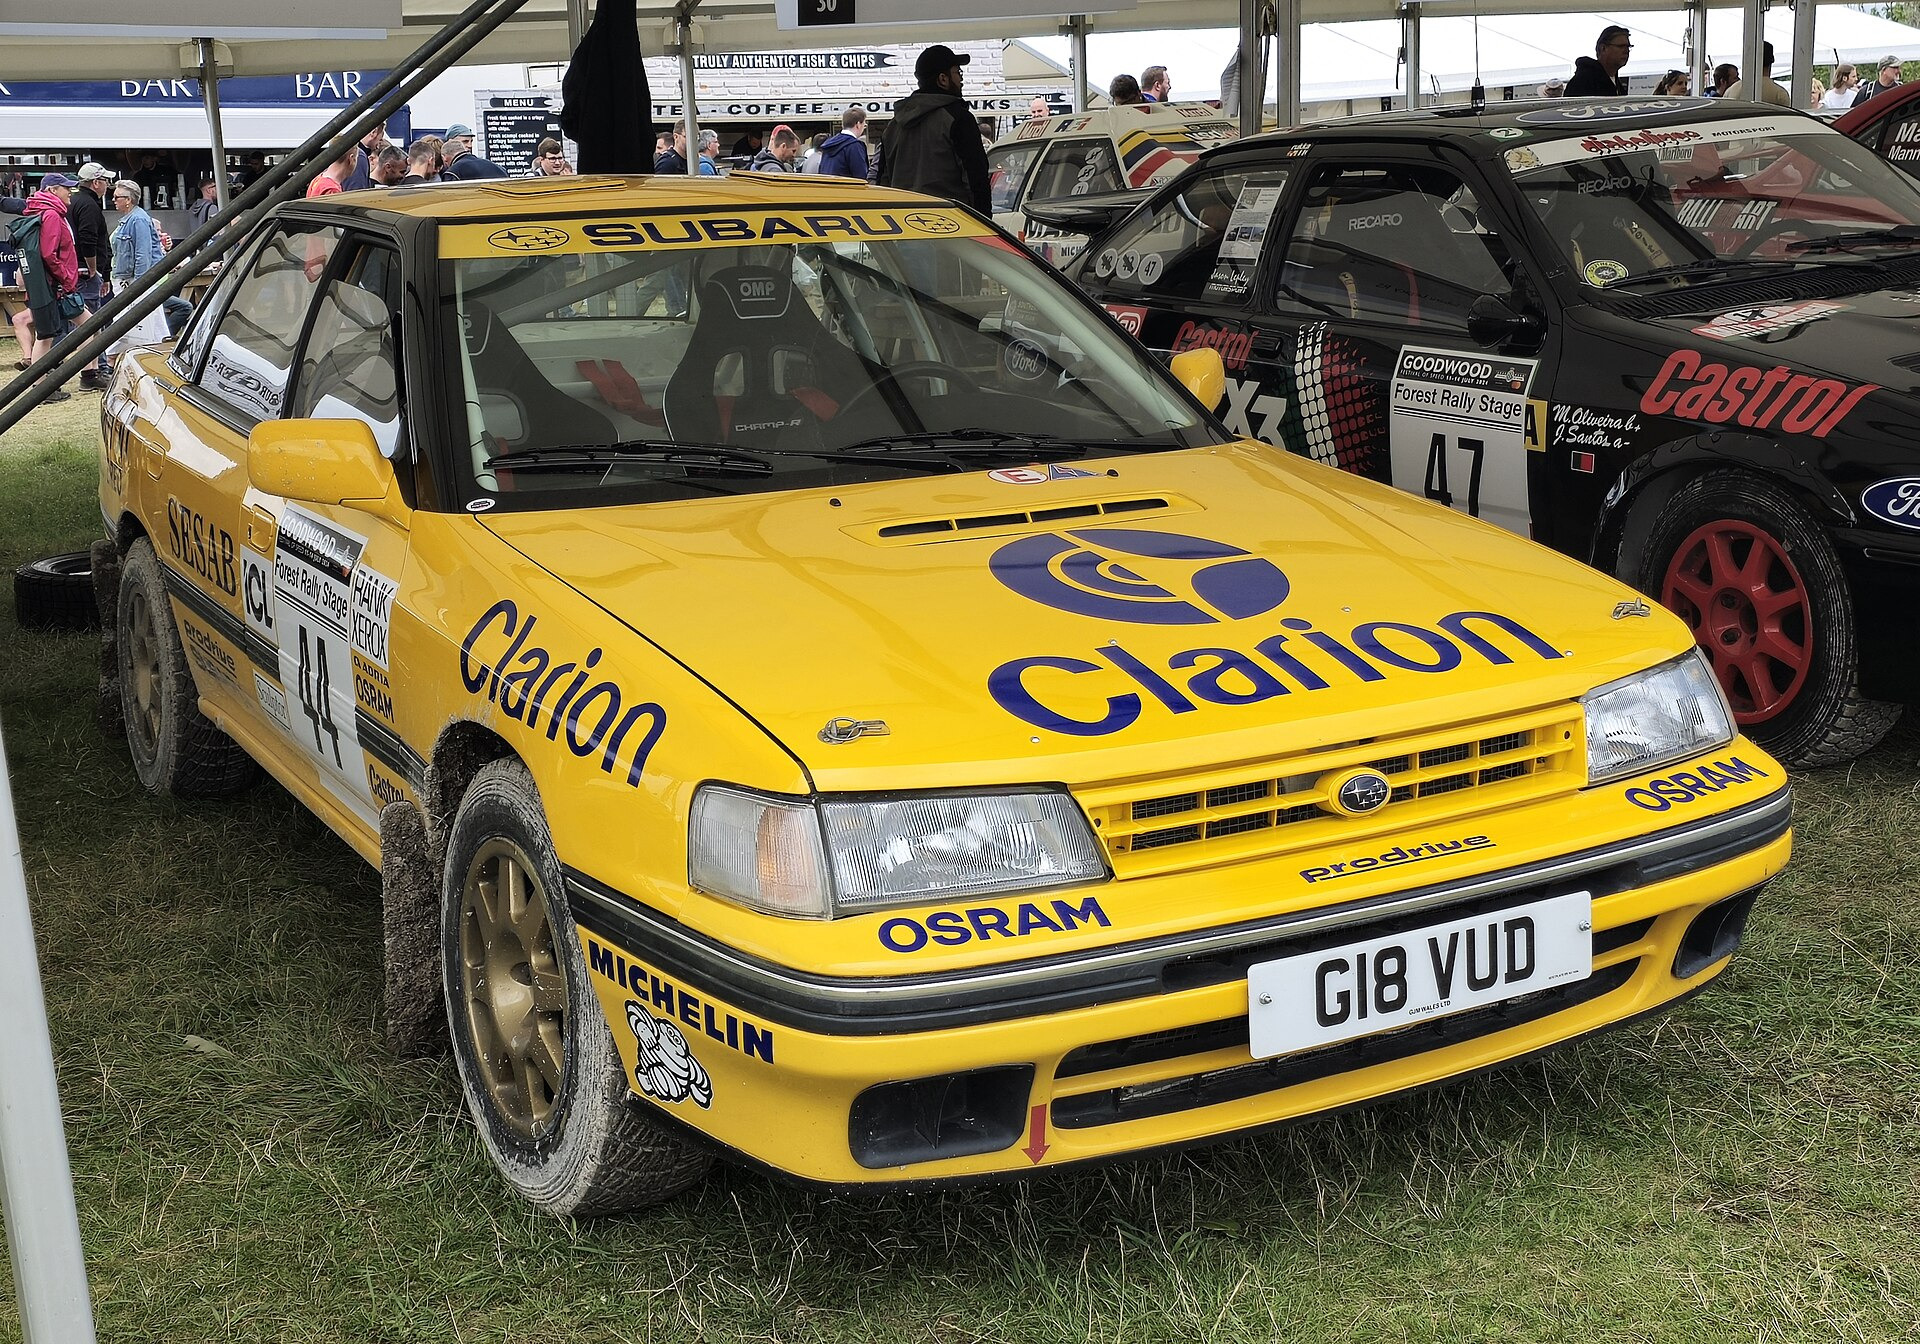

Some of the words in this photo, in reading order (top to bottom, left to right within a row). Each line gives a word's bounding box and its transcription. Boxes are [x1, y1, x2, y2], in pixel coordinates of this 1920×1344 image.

[693, 55, 730, 68] TRULY
[732, 54, 797, 68] AUTHENTIC
[799, 54, 826, 68] FISH
[829, 55, 838, 67] &
[840, 54, 876, 68] CHIPS
[121, 80, 193, 97] BAR
[296, 72, 363, 98] BAR
[504, 99, 534, 107] MENU
[653, 104, 700, 116] TE
[727, 104, 824, 115] COFFEE
[1556, 100, 1681, 118] Ford
[1711, 126, 1777, 137] MOTORSPORT
[1577, 175, 1632, 194] RECARO
[582, 214, 904, 247] SUBARU
[1348, 212, 1403, 231] RECARO
[740, 281, 775, 297] OMP
[1144, 261, 1157, 281] 47
[1011, 342, 1040, 373] Ford
[1402, 355, 1493, 379] GOODWOOD
[1394, 383, 1438, 404] Forest
[1441, 389, 1476, 413] Rally
[1479, 394, 1523, 420] Stage
[1640, 349, 1883, 437] Castrol
[735, 418, 802, 432] CHAMP-R
[1422, 432, 1485, 518] 47
[168, 497, 237, 597] SESAB
[280, 515, 337, 558] GOODWOOD
[243, 558, 274, 630] ICL
[274, 554, 300, 589] Forest
[300, 568, 321, 606] Rally
[322, 581, 348, 620] Stage
[353, 568, 395, 624] RANK
[184, 619, 236, 672] prodrive
[351, 610, 388, 665] XEROX
[298, 623, 344, 771] 44
[459, 599, 668, 788] Clarion
[987, 611, 1565, 737] Clarion
[354, 673, 396, 724] OSRAM
[1624, 756, 1770, 812] OSRAM
[1299, 833, 1492, 884] prodrive
[878, 895, 1112, 955] OSRAM
[1315, 943, 1408, 1028] G18
[1427, 915, 1536, 992] VUD
[588, 937, 775, 1065] MICHELIN
[1421, 1002, 1440, 1013] WALES
[1440, 1000, 1451, 1008] LTD
